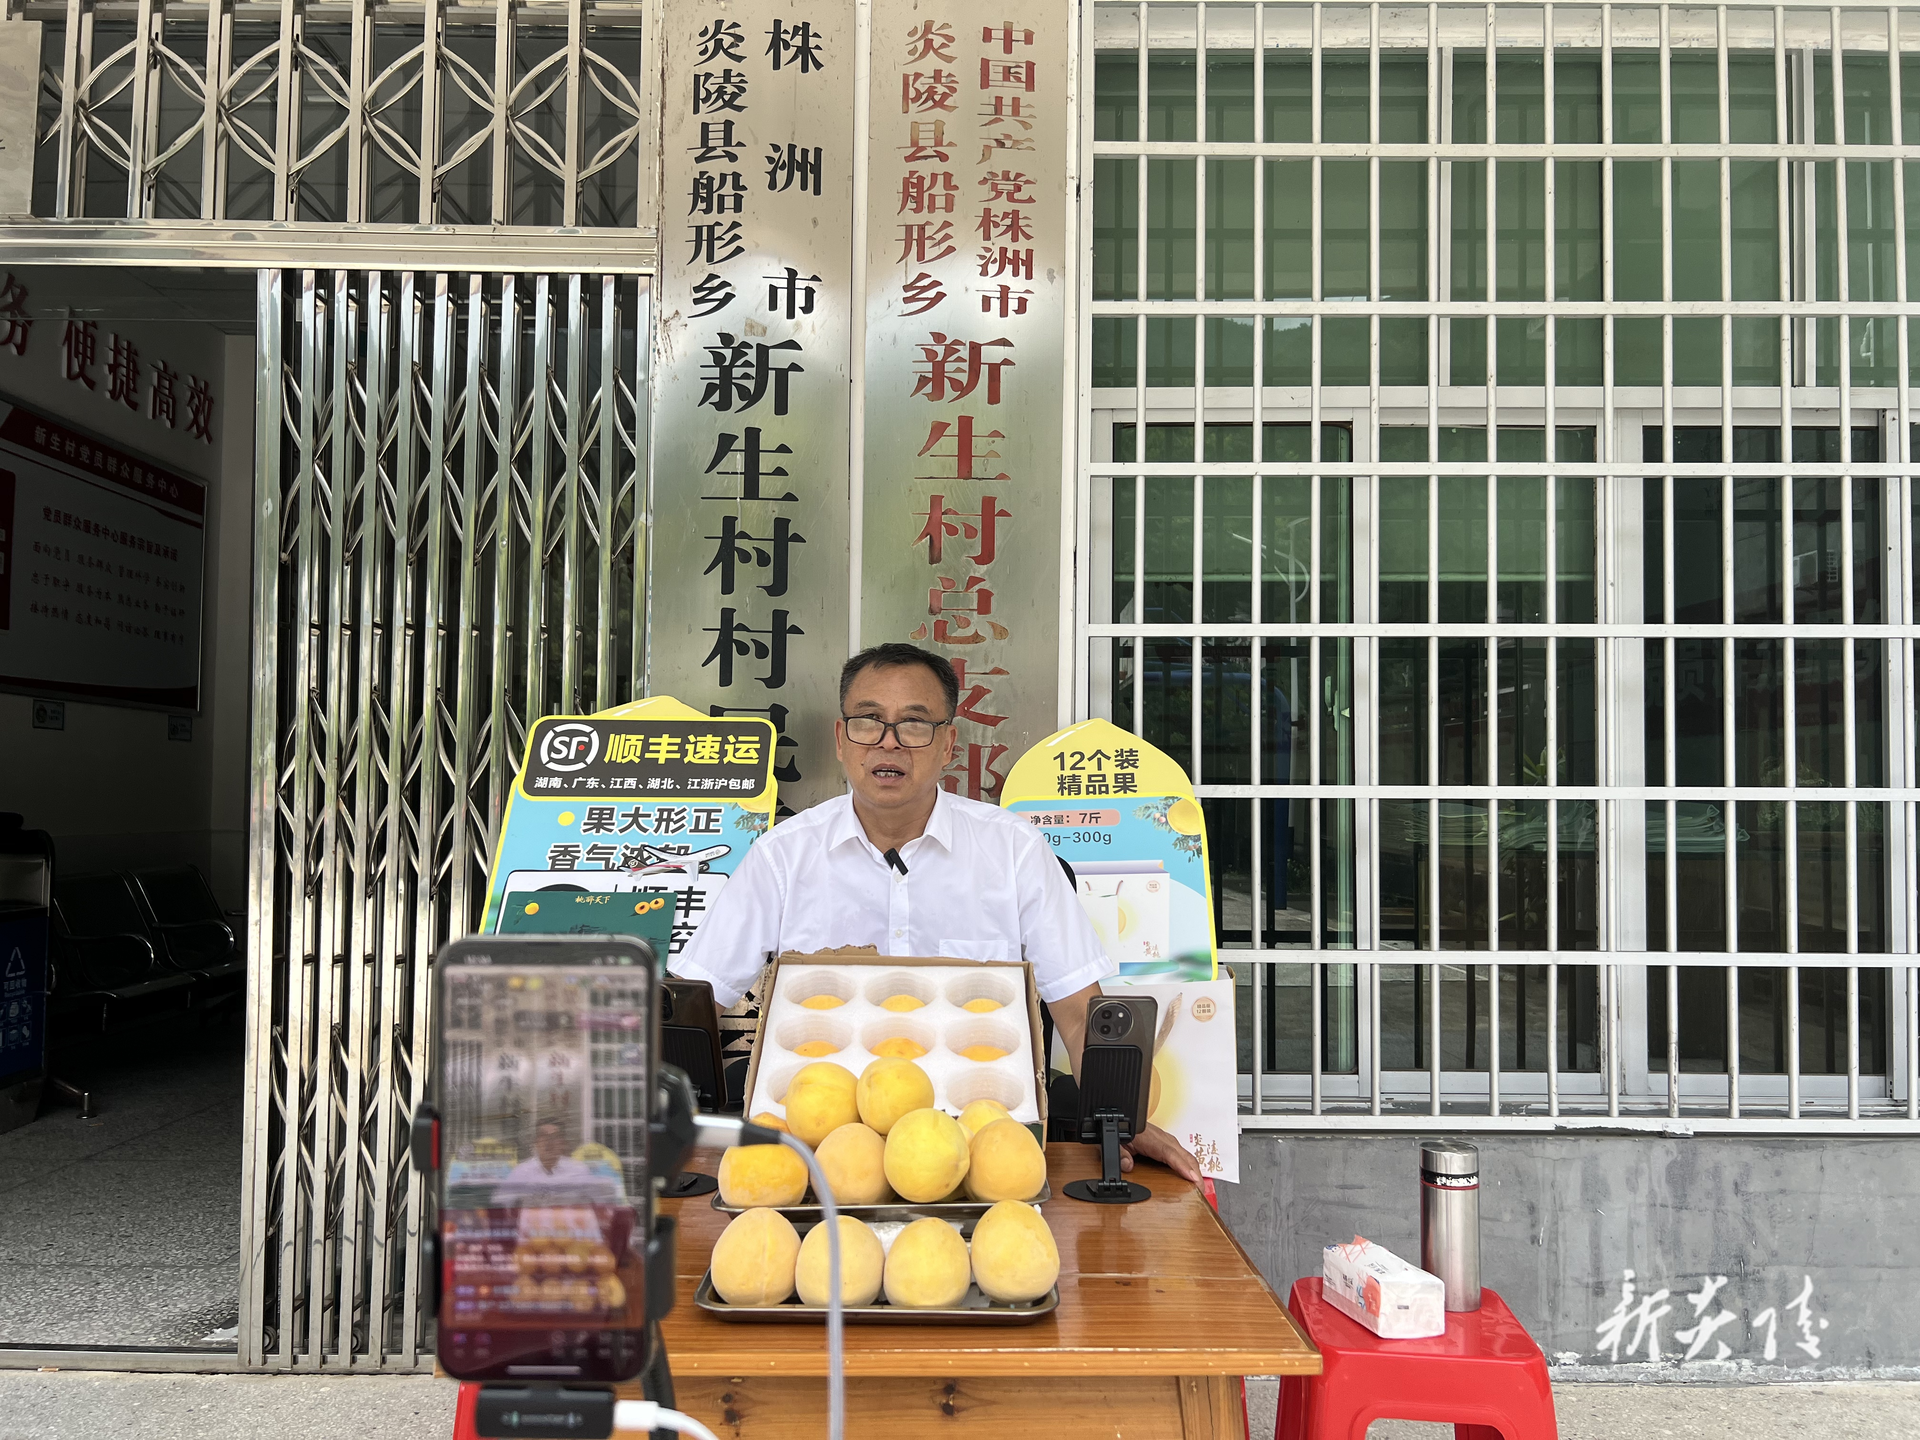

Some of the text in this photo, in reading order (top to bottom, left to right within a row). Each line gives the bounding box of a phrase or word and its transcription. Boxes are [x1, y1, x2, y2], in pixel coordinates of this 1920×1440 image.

[685, 19, 749, 319] 炎陵县船形乡
[762, 18, 825, 320] 株洲市
[895, 19, 960, 319] 炎陵县船形乡
[974, 20, 1038, 319] 中国共产党株洲市
[57, 305, 215, 446] 便捷高效
[34, 424, 180, 499] 新生村党员群众服务中心
[603, 733, 761, 765] 顺丰速运
[1053, 748, 1139, 771] 12个装
[1057, 772, 1138, 796] 精品果
[581, 806, 723, 835] 果大形正
